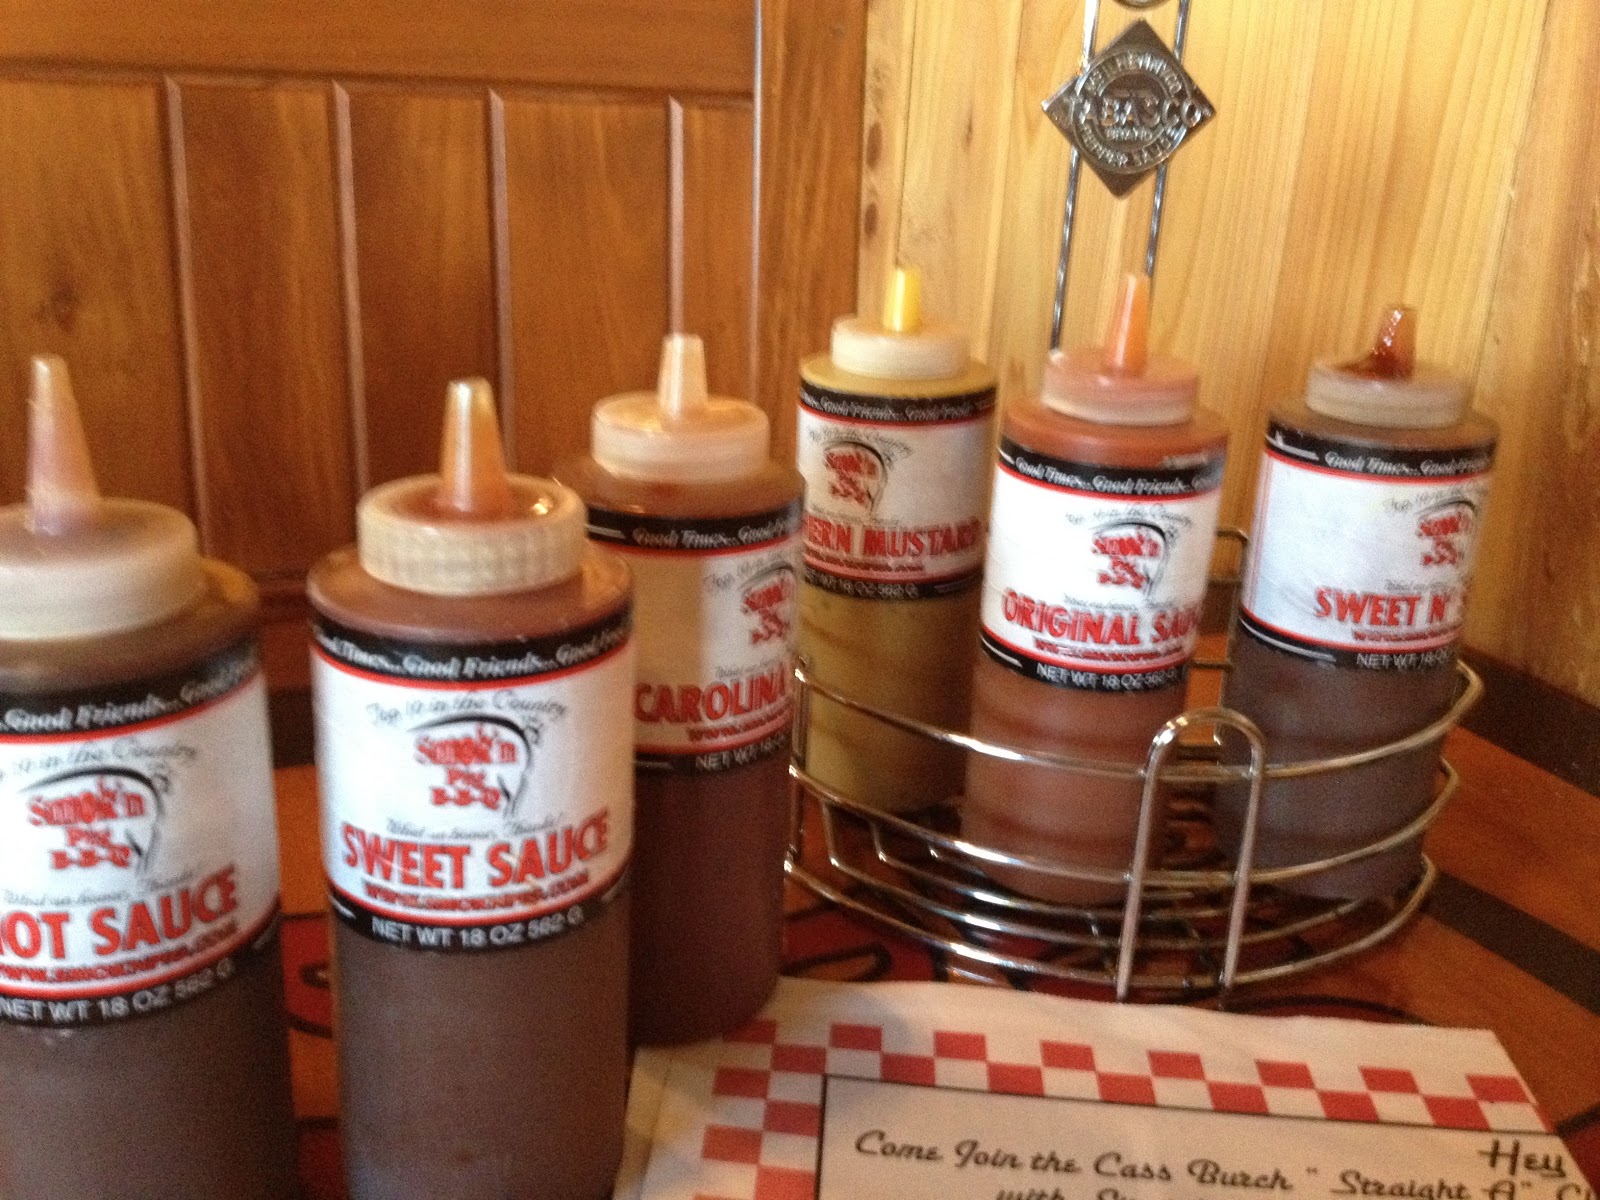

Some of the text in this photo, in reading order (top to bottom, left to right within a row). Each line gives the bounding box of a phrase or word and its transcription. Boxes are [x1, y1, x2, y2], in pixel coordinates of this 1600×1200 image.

[1002, 587, 1140, 645] ORIGINAL
[1314, 586, 1420, 626] SWEET
[401, 654, 460, 678] Good
[1356, 653, 1389, 670] NET
[5, 707, 73, 731] Good
[341, 821, 471, 889] SWEET
[487, 807, 608, 888] SAUCE
[0, 910, 71, 960] OT
[90, 862, 237, 957] SAUCE
[371, 915, 412, 944] NET
[416, 926, 453, 947] WT
[459, 928, 488, 948] 18
[489, 922, 525, 945] OZ
[48, 1000, 92, 1023] WT
[99, 996, 130, 1020] 18
[132, 984, 172, 1011] OZ
[855, 1129, 943, 1163] Come
[953, 1139, 1024, 1170] Join
[1029, 1149, 1082, 1174] the
[1092, 1151, 1172, 1182] Cass
[1186, 1158, 1294, 1191] Burch
[1330, 1169, 1472, 1200] Straight
[1477, 1138, 1566, 1178] Hey
